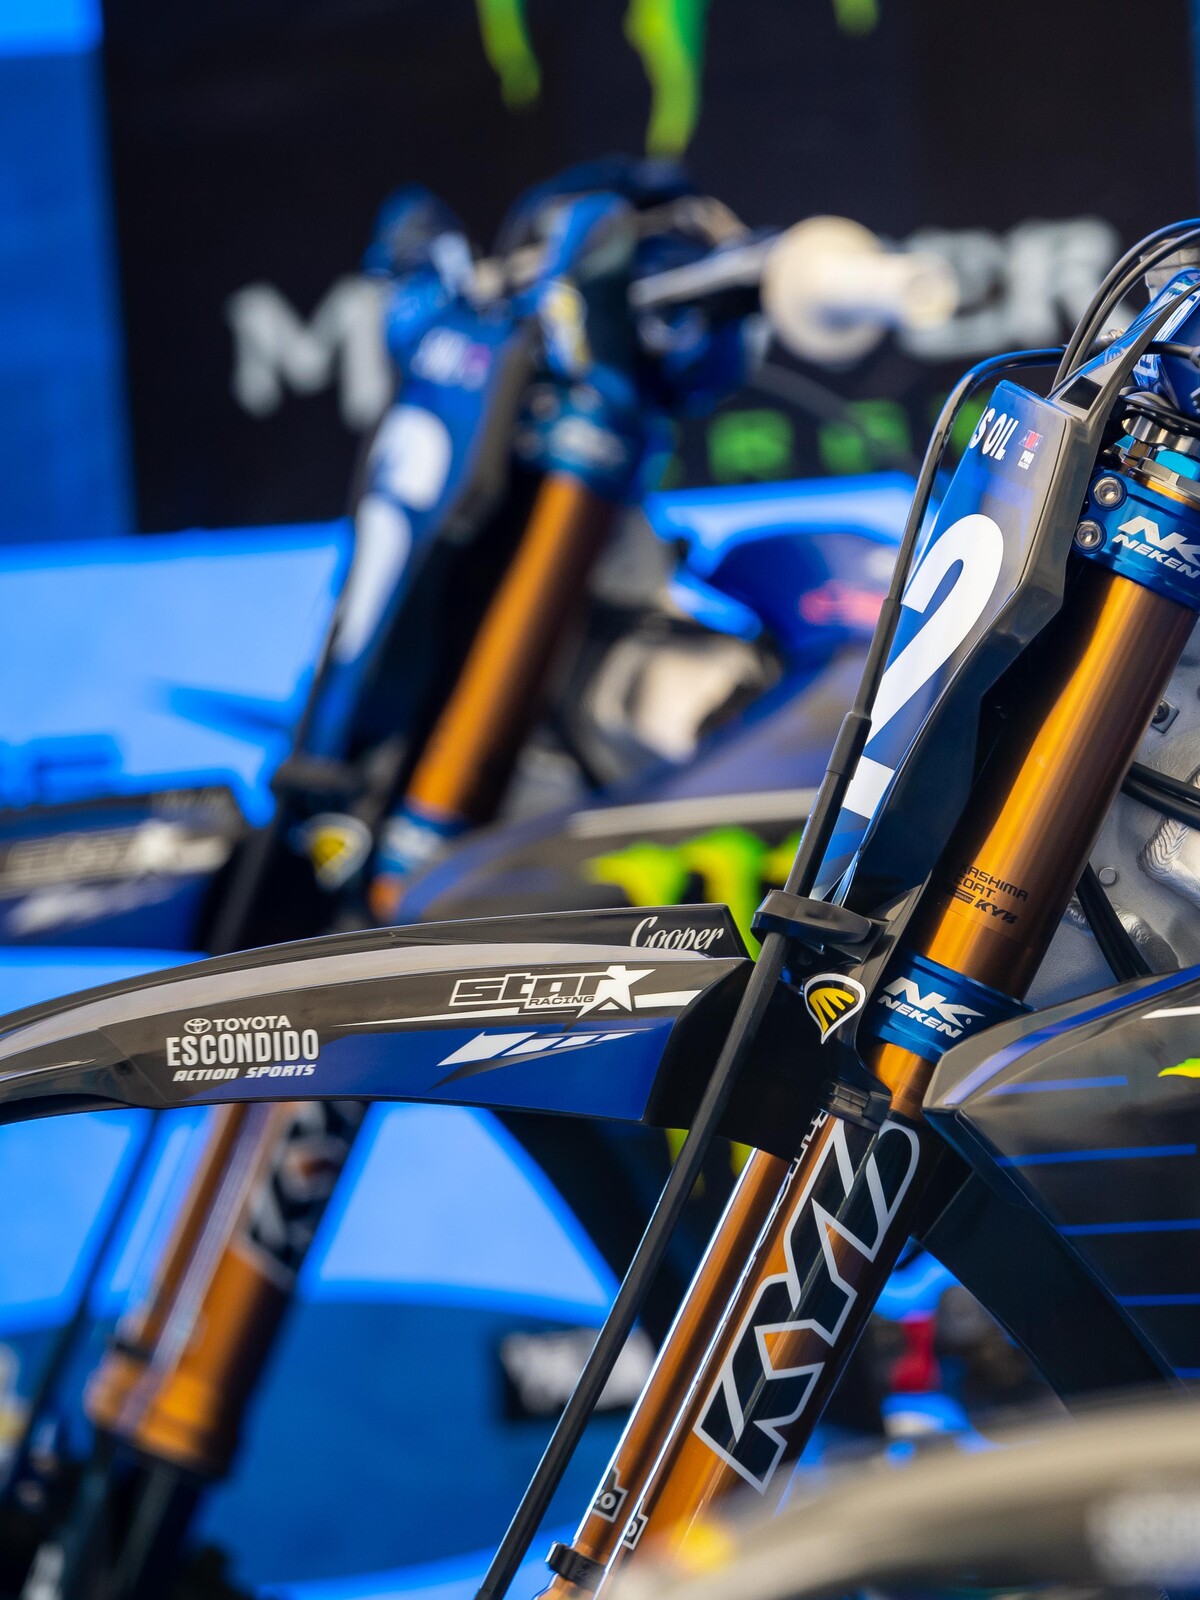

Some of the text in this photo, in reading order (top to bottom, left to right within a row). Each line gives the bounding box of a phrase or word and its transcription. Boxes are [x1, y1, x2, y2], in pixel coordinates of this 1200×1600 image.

[981, 413, 1020, 461] OIL
[951, 873, 997, 899] COAT
[961, 863, 1029, 902] KASHIMA
[974, 898, 1019, 925] KYB
[630, 915, 725, 951] Cooper
[449, 968, 636, 1012] star
[528, 994, 596, 1007] RACING
[882, 975, 987, 1029] NK
[212, 1014, 292, 1032] TOYOTA
[877, 994, 964, 1039] NEKEN
[165, 1028, 320, 1067] ESCONDIDO
[172, 1063, 317, 1082] ACTION SPORTS
[692, 1118, 920, 1496] KYB
